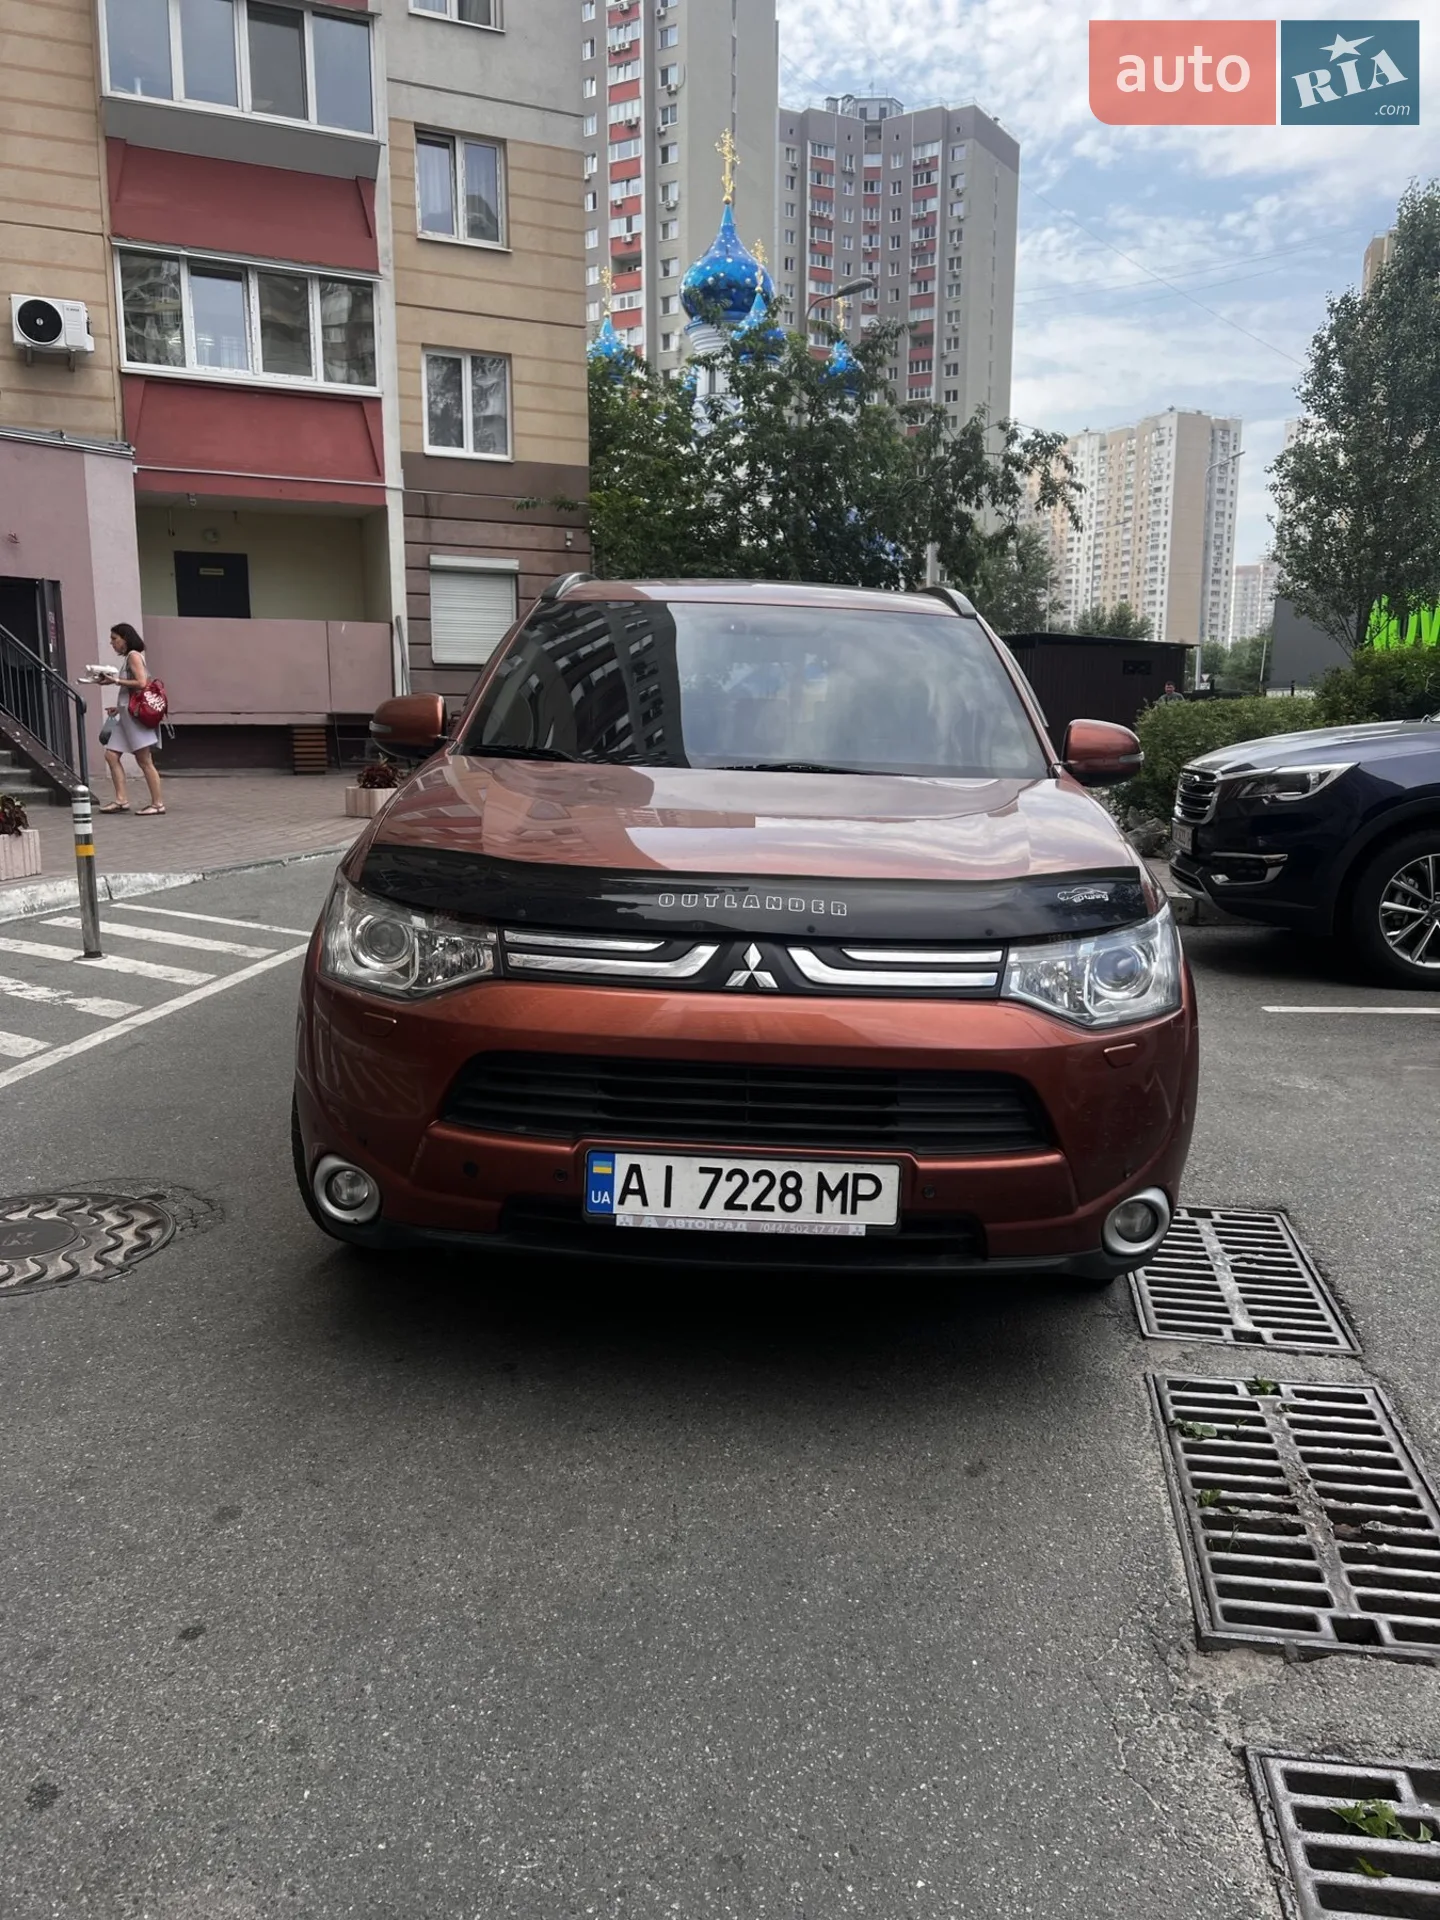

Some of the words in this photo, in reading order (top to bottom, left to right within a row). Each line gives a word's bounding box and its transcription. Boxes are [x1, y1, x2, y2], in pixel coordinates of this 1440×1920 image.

[658, 893, 847, 916] OUTLANDER
[591, 1190, 611, 1204] UA
[617, 1163, 674, 1209] AI
[698, 1166, 803, 1213] 7228
[815, 1171, 883, 1215] MP
[664, 1218, 749, 1232] АВТОГРАД
